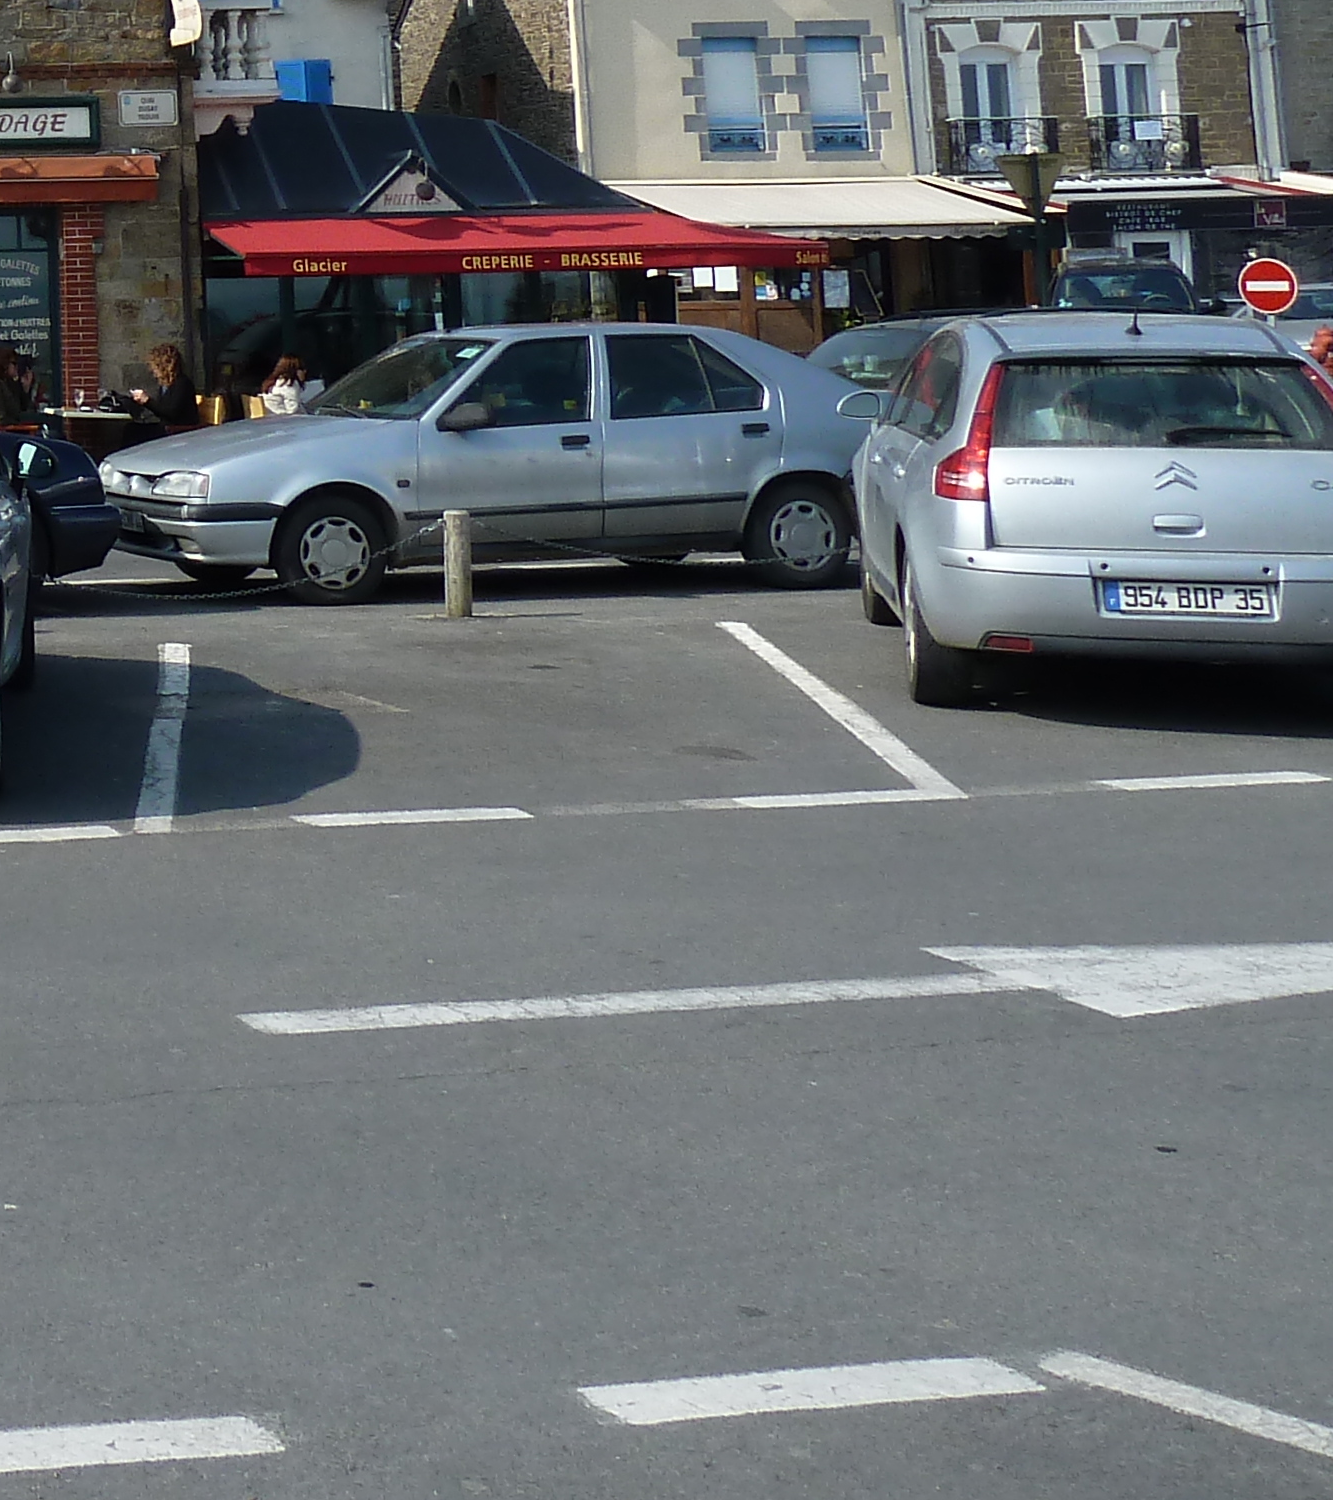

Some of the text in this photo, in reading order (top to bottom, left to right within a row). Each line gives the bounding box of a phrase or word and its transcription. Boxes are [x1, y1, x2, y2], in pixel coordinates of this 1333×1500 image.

[292, 258, 347, 273] Glacier
[462, 255, 534, 270] CREPERIE
[560, 252, 644, 267] BRASSERIE
[795, 250, 820, 265] Salon
[10, 329, 49, 340] Galettes
[1124, 585, 1168, 608] 954
[1175, 587, 1224, 609] BDP
[1234, 588, 1264, 610] 35
